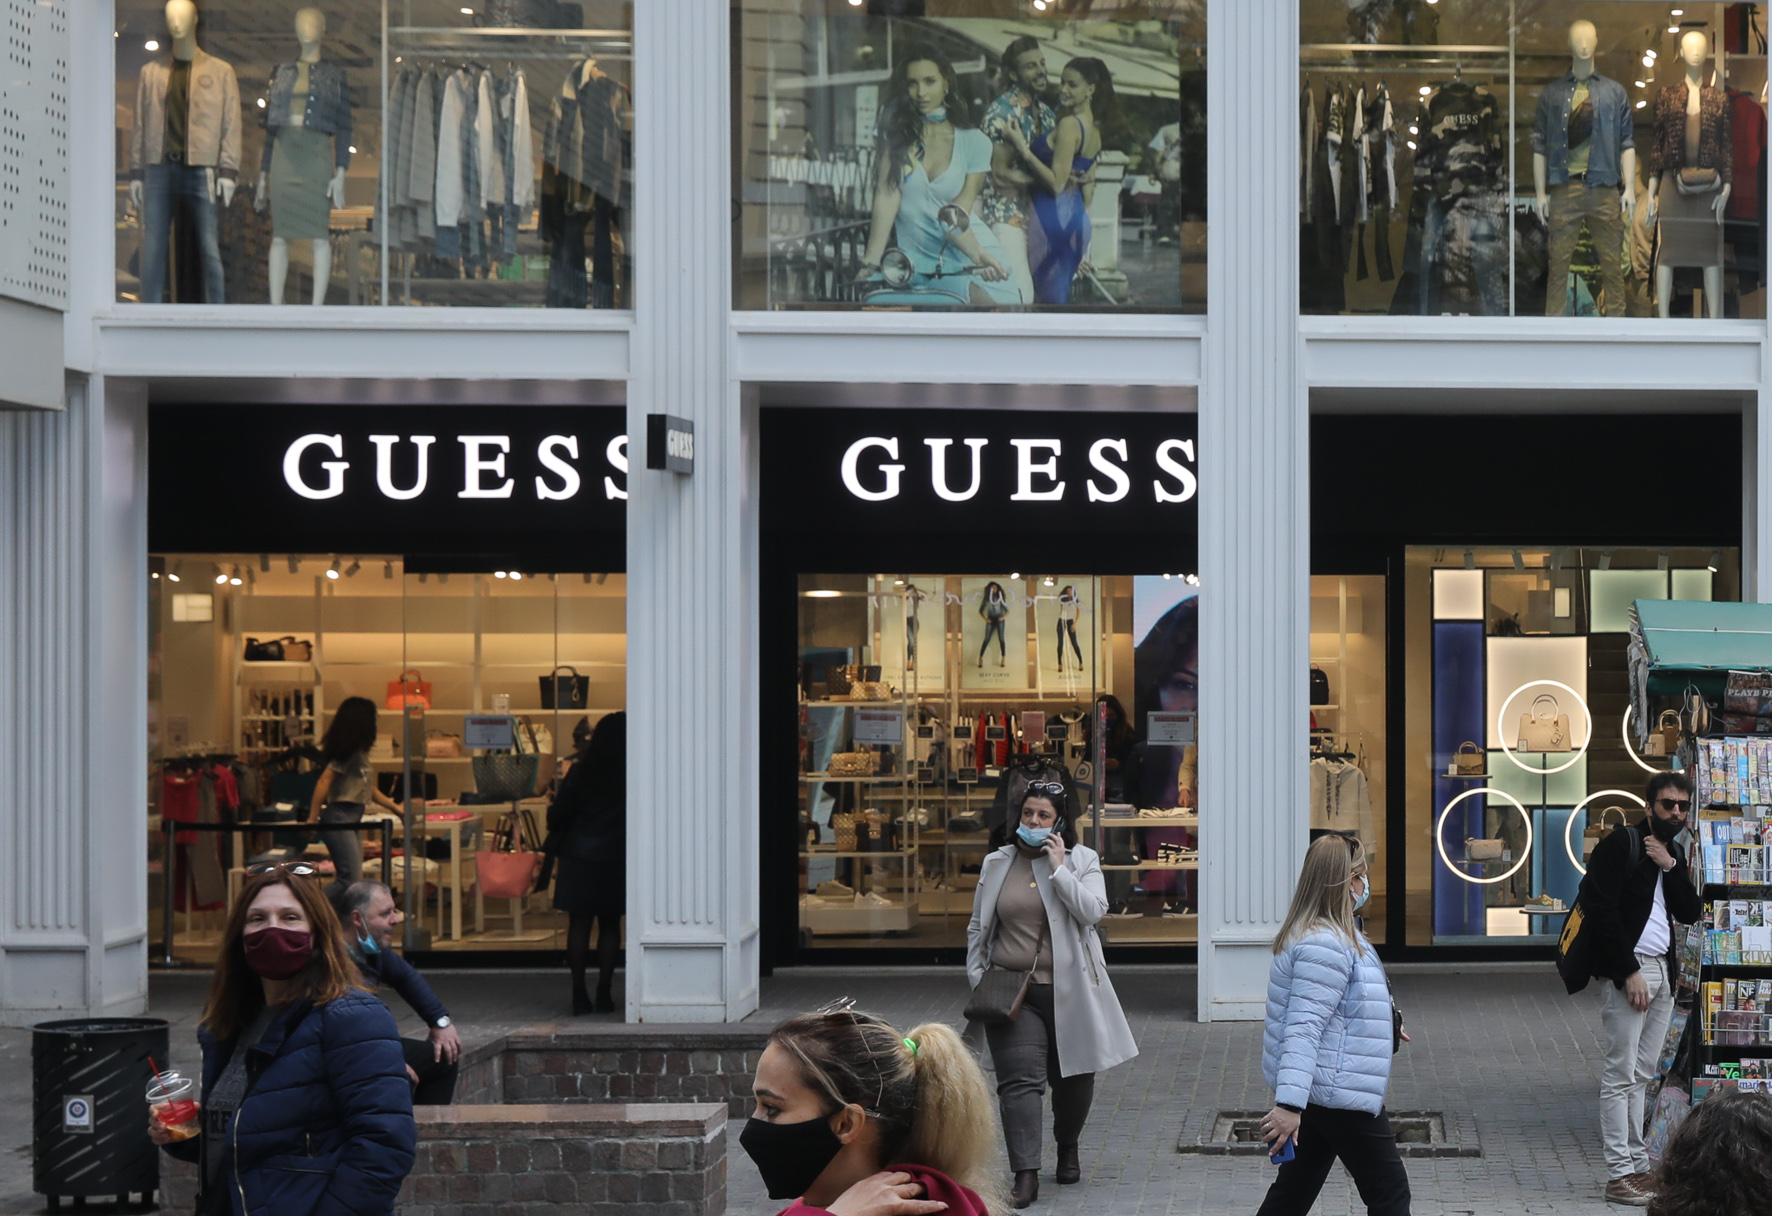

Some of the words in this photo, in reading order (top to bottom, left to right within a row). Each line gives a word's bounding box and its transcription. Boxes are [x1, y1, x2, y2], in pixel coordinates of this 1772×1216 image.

[667, 428, 694, 461] GUESS
[841, 436, 1199, 502] GUESS
[1740, 1081, 1760, 1089] mari
